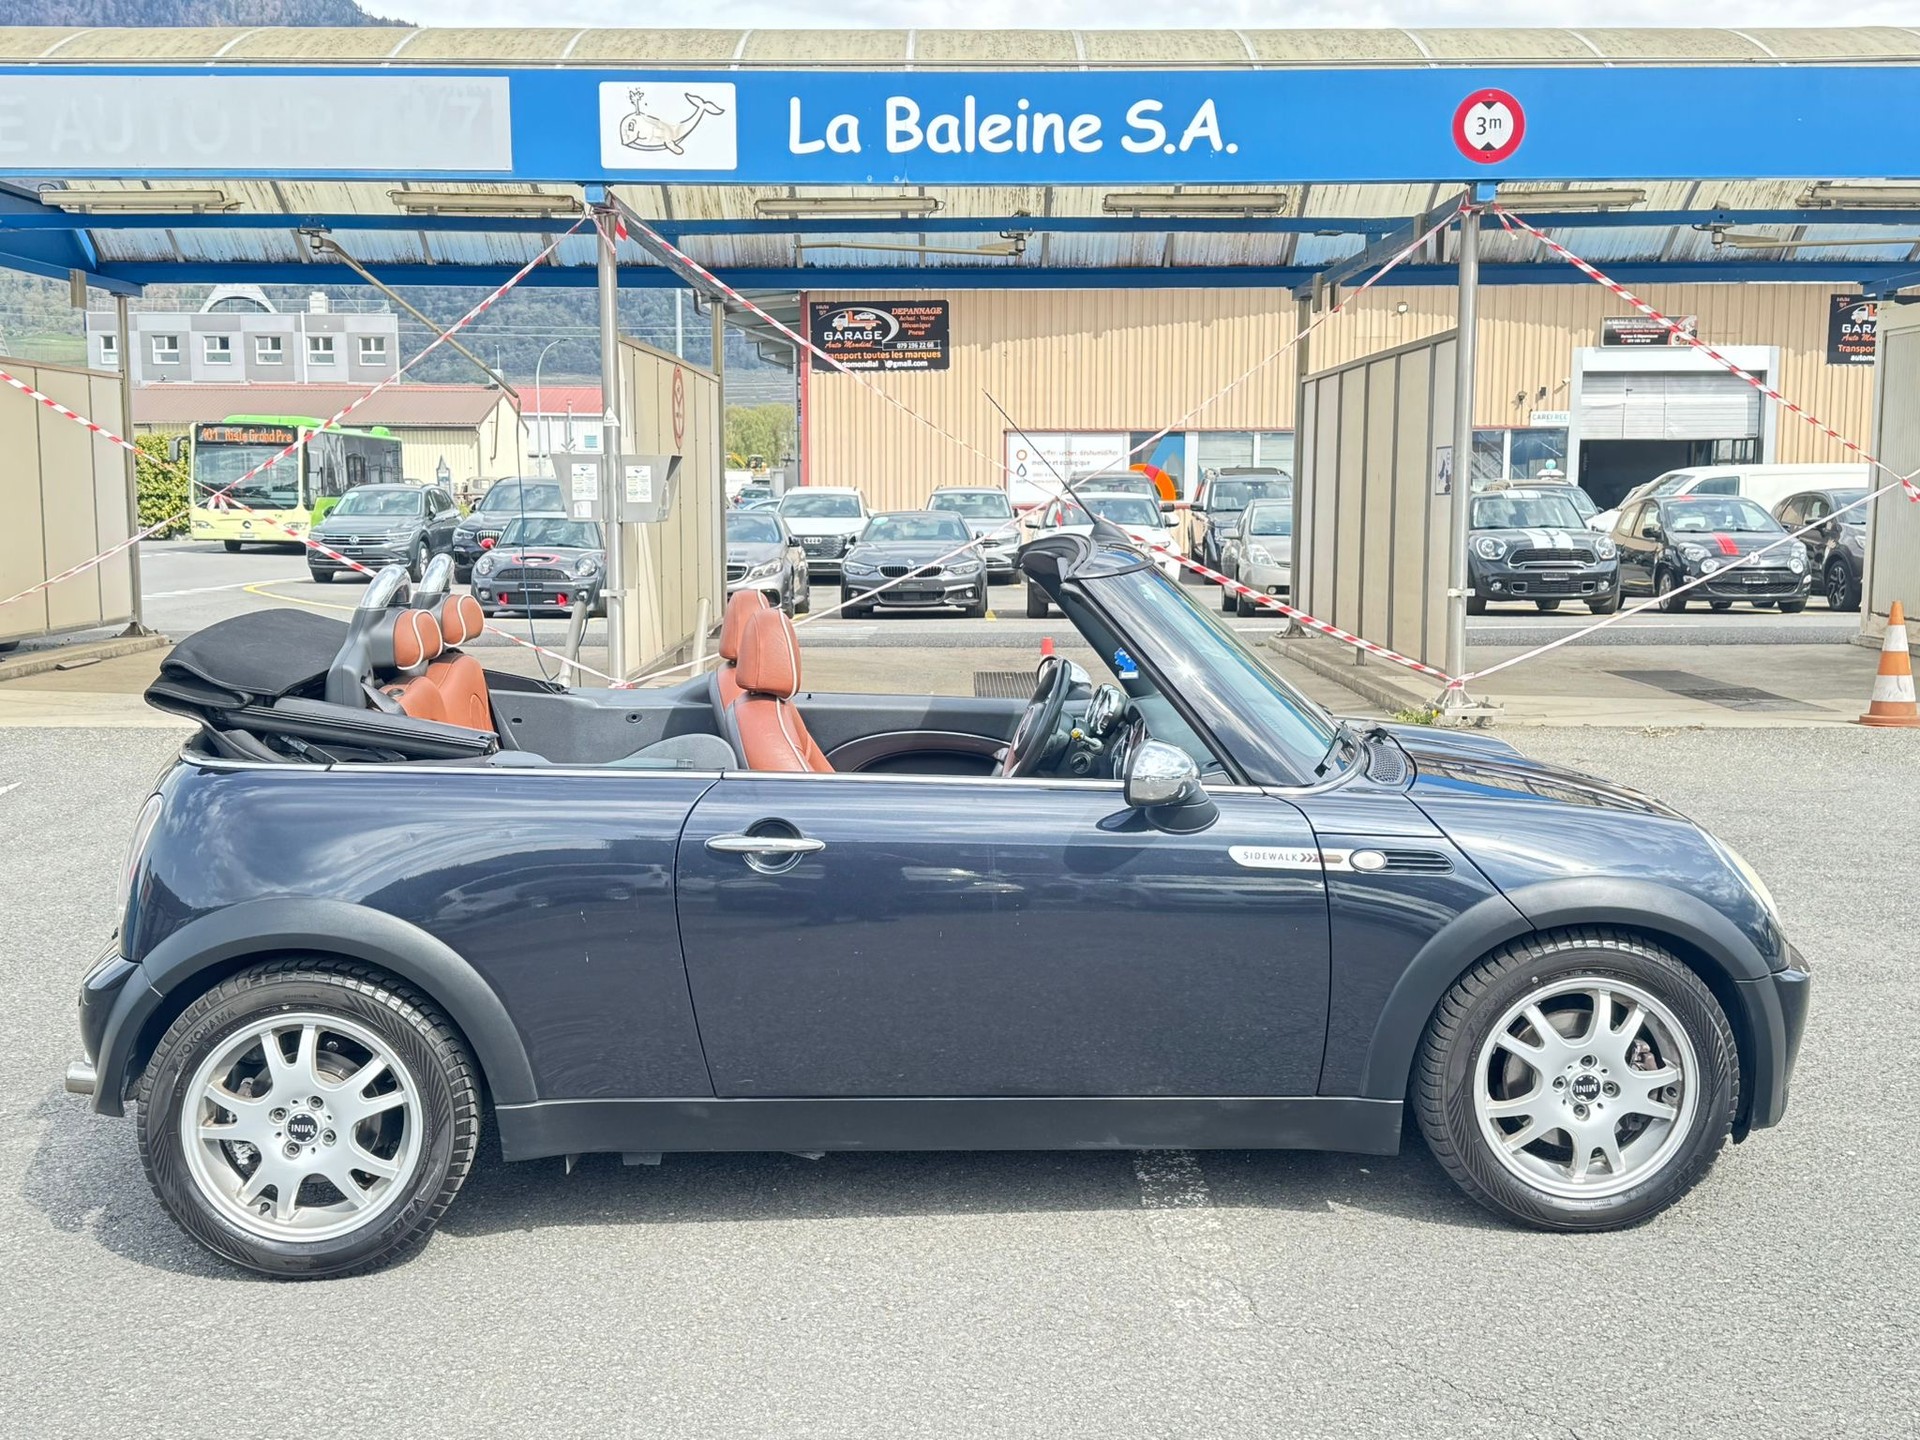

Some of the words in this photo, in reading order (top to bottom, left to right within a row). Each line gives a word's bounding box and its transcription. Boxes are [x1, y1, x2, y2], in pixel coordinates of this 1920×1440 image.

[789, 97, 862, 154] La
[886, 95, 1103, 154] Baleine
[1121, 98, 1238, 154] S.A.
[891, 307, 942, 315] DEPANNAGE
[823, 330, 883, 341] GARAGE
[1841, 333, 1860, 342] Auto
[825, 340, 842, 349] Auto
[844, 339, 873, 349] Mondial
[863, 351, 890, 359] toutes
[891, 351, 904, 359] les
[905, 351, 941, 361] marques
[1243, 851, 1298, 862] SIDEWALK
[1575, 1084, 1598, 1093] MINI
[291, 1124, 314, 1133] MINI
